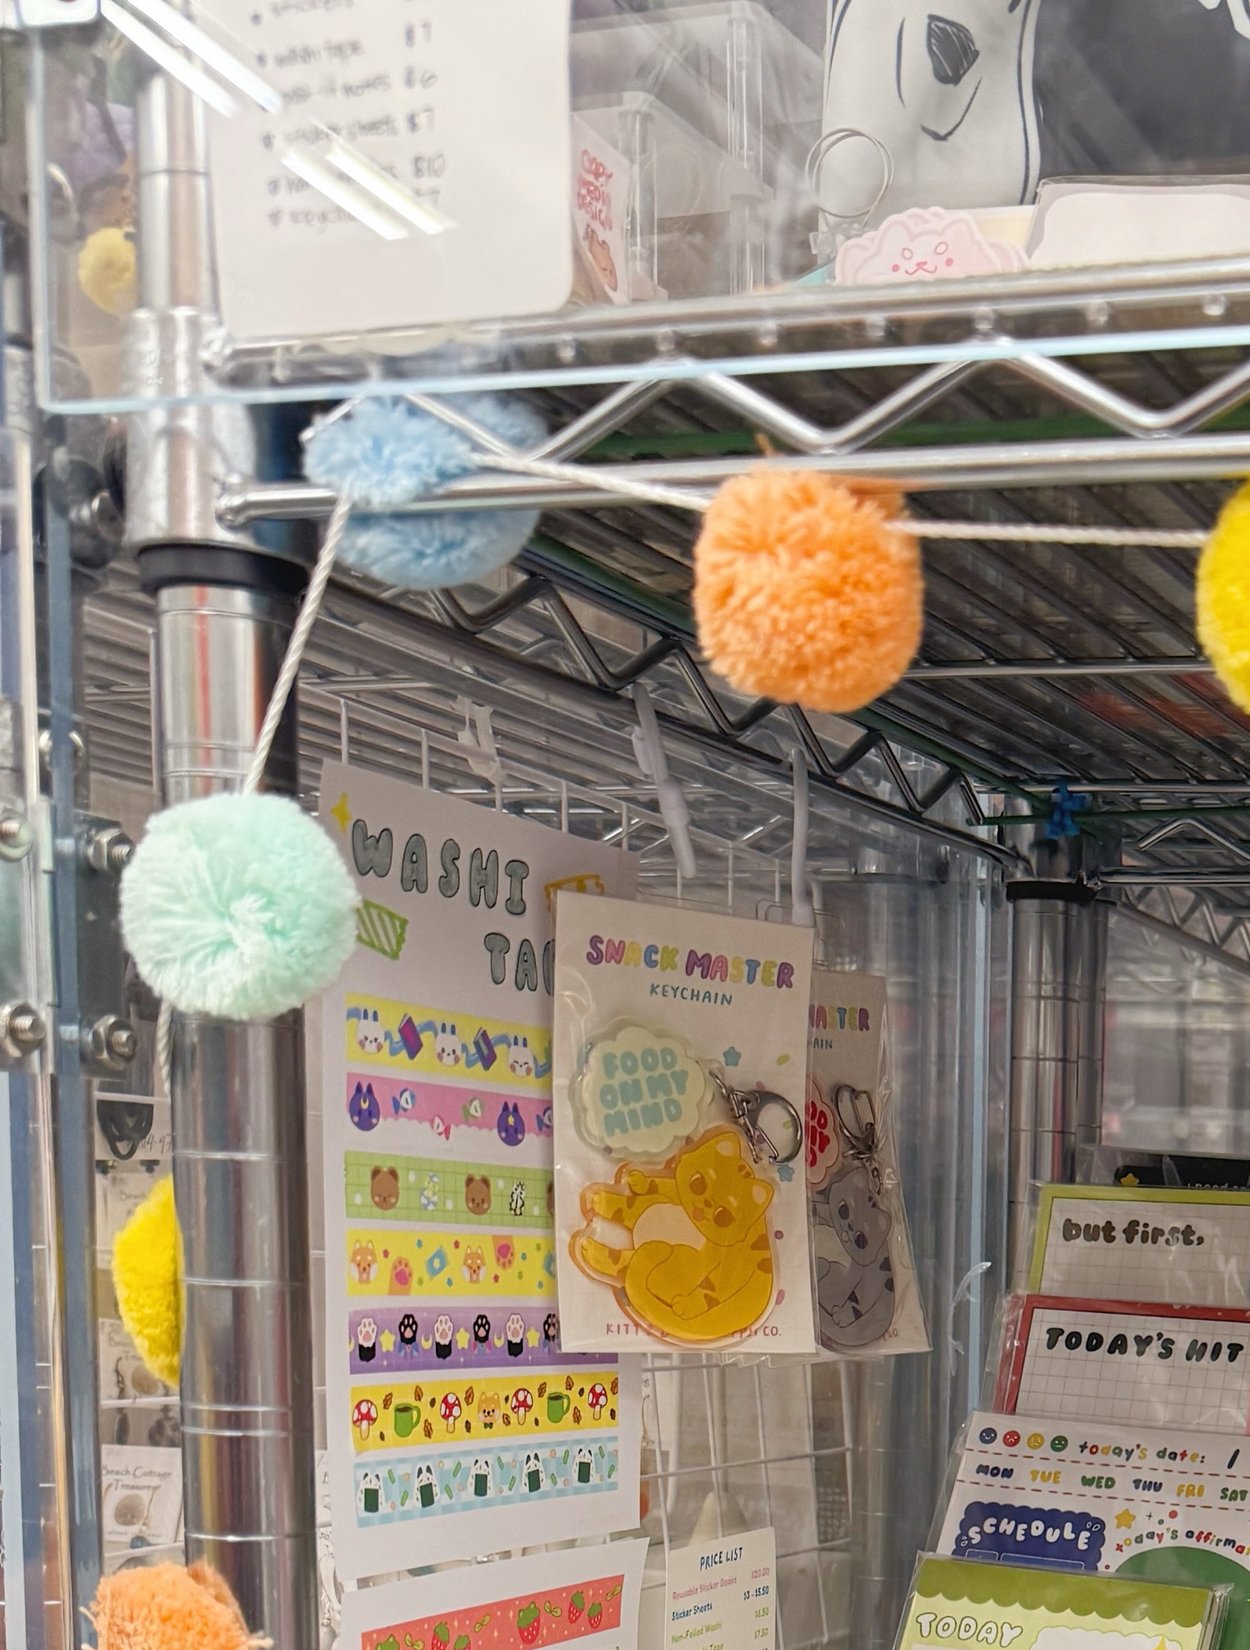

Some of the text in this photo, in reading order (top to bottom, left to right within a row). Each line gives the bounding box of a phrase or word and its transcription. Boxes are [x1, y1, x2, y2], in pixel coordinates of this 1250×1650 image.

[352, 819, 529, 915] WASHI
[586, 935, 794, 989] SNACK MASTER
[650, 983, 733, 1006] KEYCHAIN
[602, 1046, 678, 1080] FOOD
[600, 1069, 689, 1110] ON MY
[603, 1098, 683, 1137] MIND
[1062, 1218, 1205, 1247] but first,
[1046, 1327, 1176, 1360] TODAY'S
[1185, 1339, 1245, 1362] HIT
[1079, 1441, 1206, 1465] today's date:
[975, 1463, 1014, 1480] MON
[1029, 1469, 1062, 1485] TUE
[1081, 1475, 1116, 1490] WED
[1132, 1478, 1163, 1493] THU
[1175, 1482, 1205, 1498] FRI
[1219, 1487, 1249, 1502] SAT
[967, 1517, 1091, 1551] SCHEDULE
[1114, 1527, 1180, 1553] today's
[699, 1547, 743, 1571] PRICE LIST
[671, 1602, 713, 1621] Sticker Sheets
[915, 1612, 1024, 1648] TODAY
